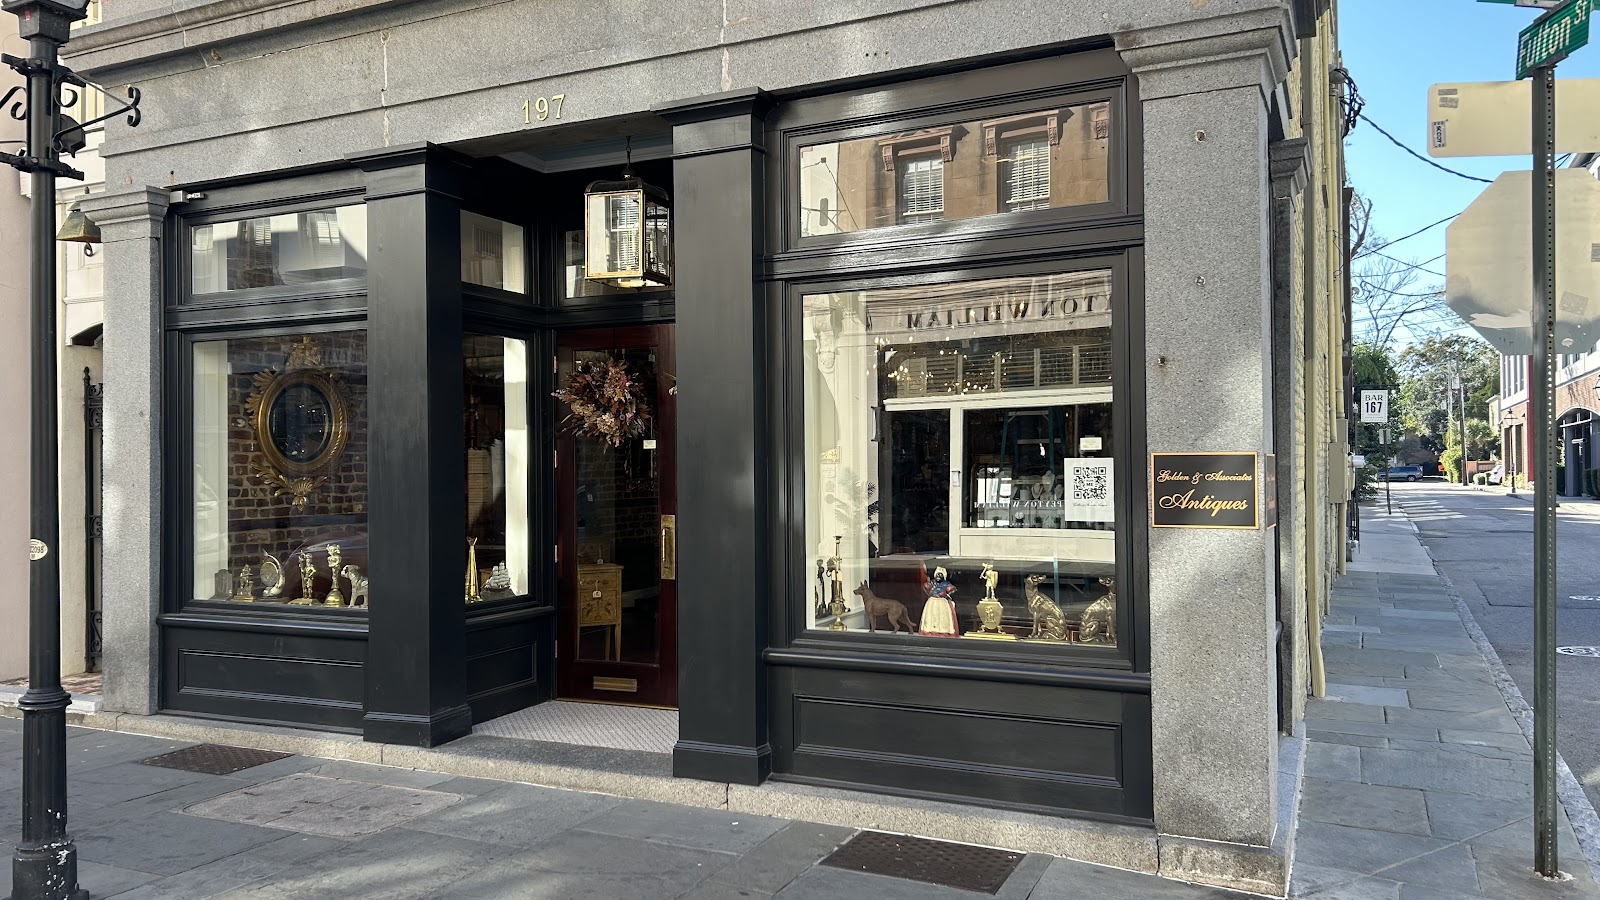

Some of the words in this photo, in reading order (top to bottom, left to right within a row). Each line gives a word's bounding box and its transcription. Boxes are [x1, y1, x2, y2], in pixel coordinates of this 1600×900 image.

[1518, 20, 1570, 73] Fulton
[1574, 0, 1587, 24] St
[522, 93, 566, 124] 197
[1365, 402, 1382, 413] 167
[1157, 469, 1190, 482] Golden
[1191, 472, 1203, 485] &
[1204, 470, 1253, 481] Associates
[1159, 489, 1248, 517] Antiques
